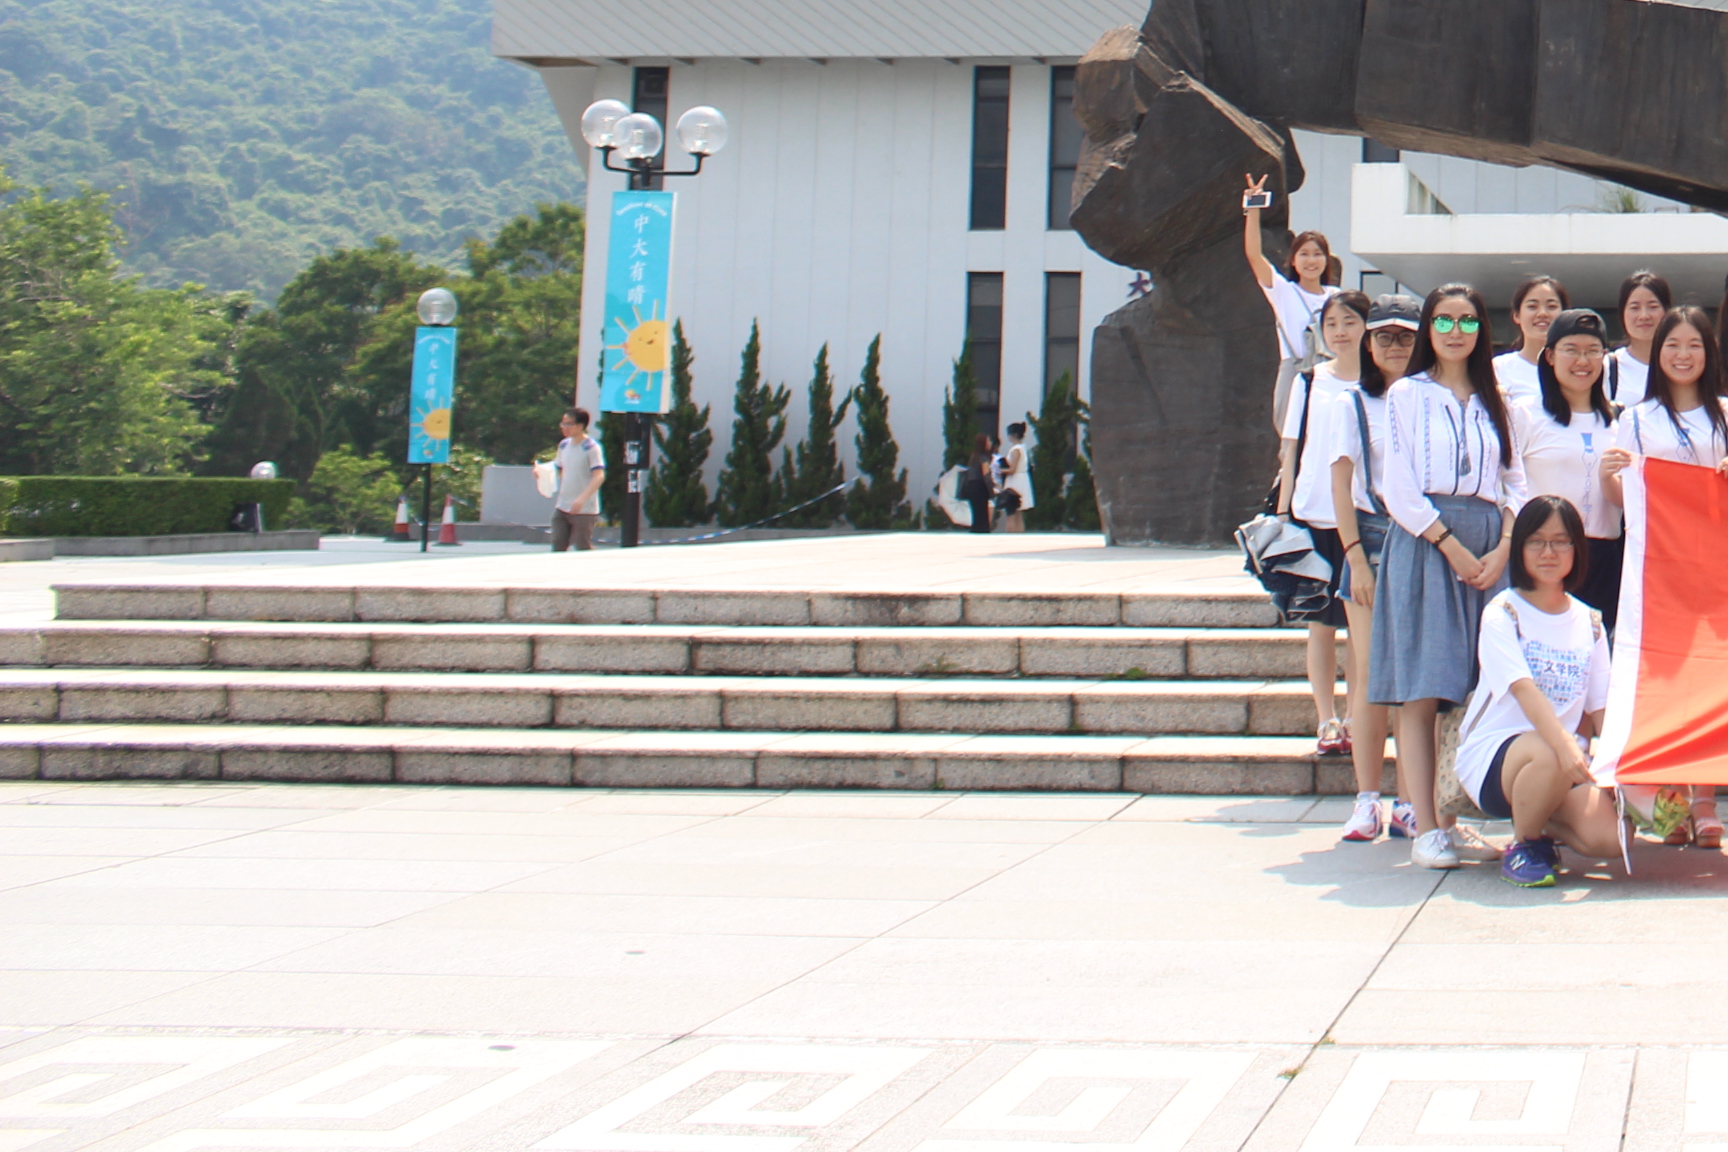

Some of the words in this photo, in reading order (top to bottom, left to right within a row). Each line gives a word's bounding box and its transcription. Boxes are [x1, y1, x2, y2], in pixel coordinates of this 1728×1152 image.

[626, 214, 650, 305] 中大有晴
[1544, 660, 1581, 679] 文学院
